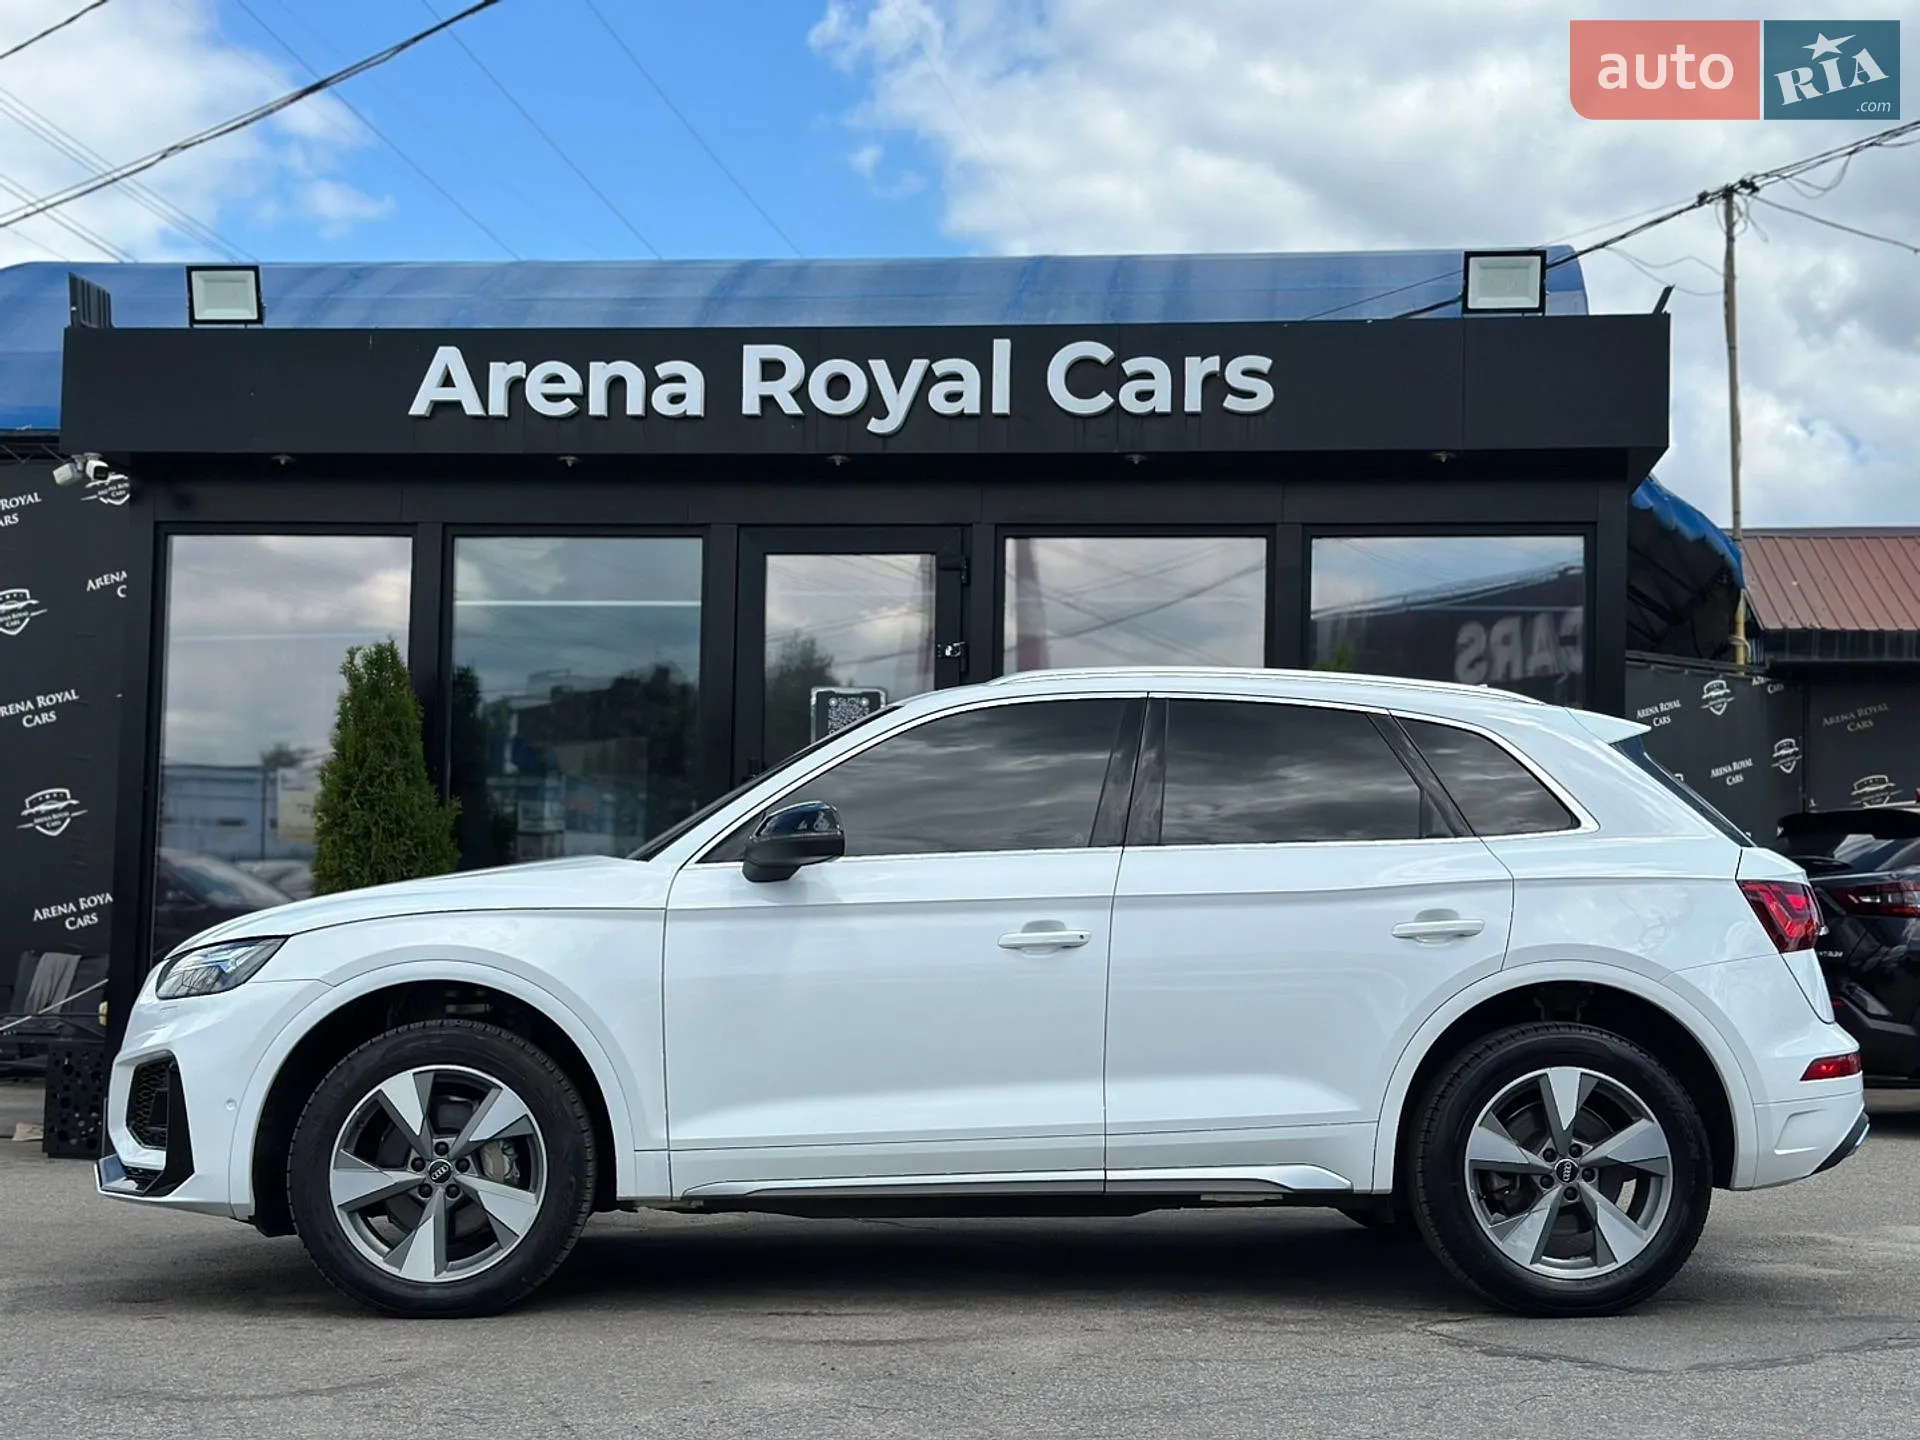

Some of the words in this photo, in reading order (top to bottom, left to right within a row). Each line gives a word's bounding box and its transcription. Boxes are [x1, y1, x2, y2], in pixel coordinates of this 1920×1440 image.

[408, 345, 706, 419] Arena
[740, 338, 1011, 436] Royal
[1046, 341, 1275, 416] Cars
[0, 492, 42, 510] ROYAL
[36, 689, 79, 709] ROYAL
[22, 710, 57, 728] CARS
[33, 901, 77, 922] ARENA
[65, 912, 98, 930] CARS
